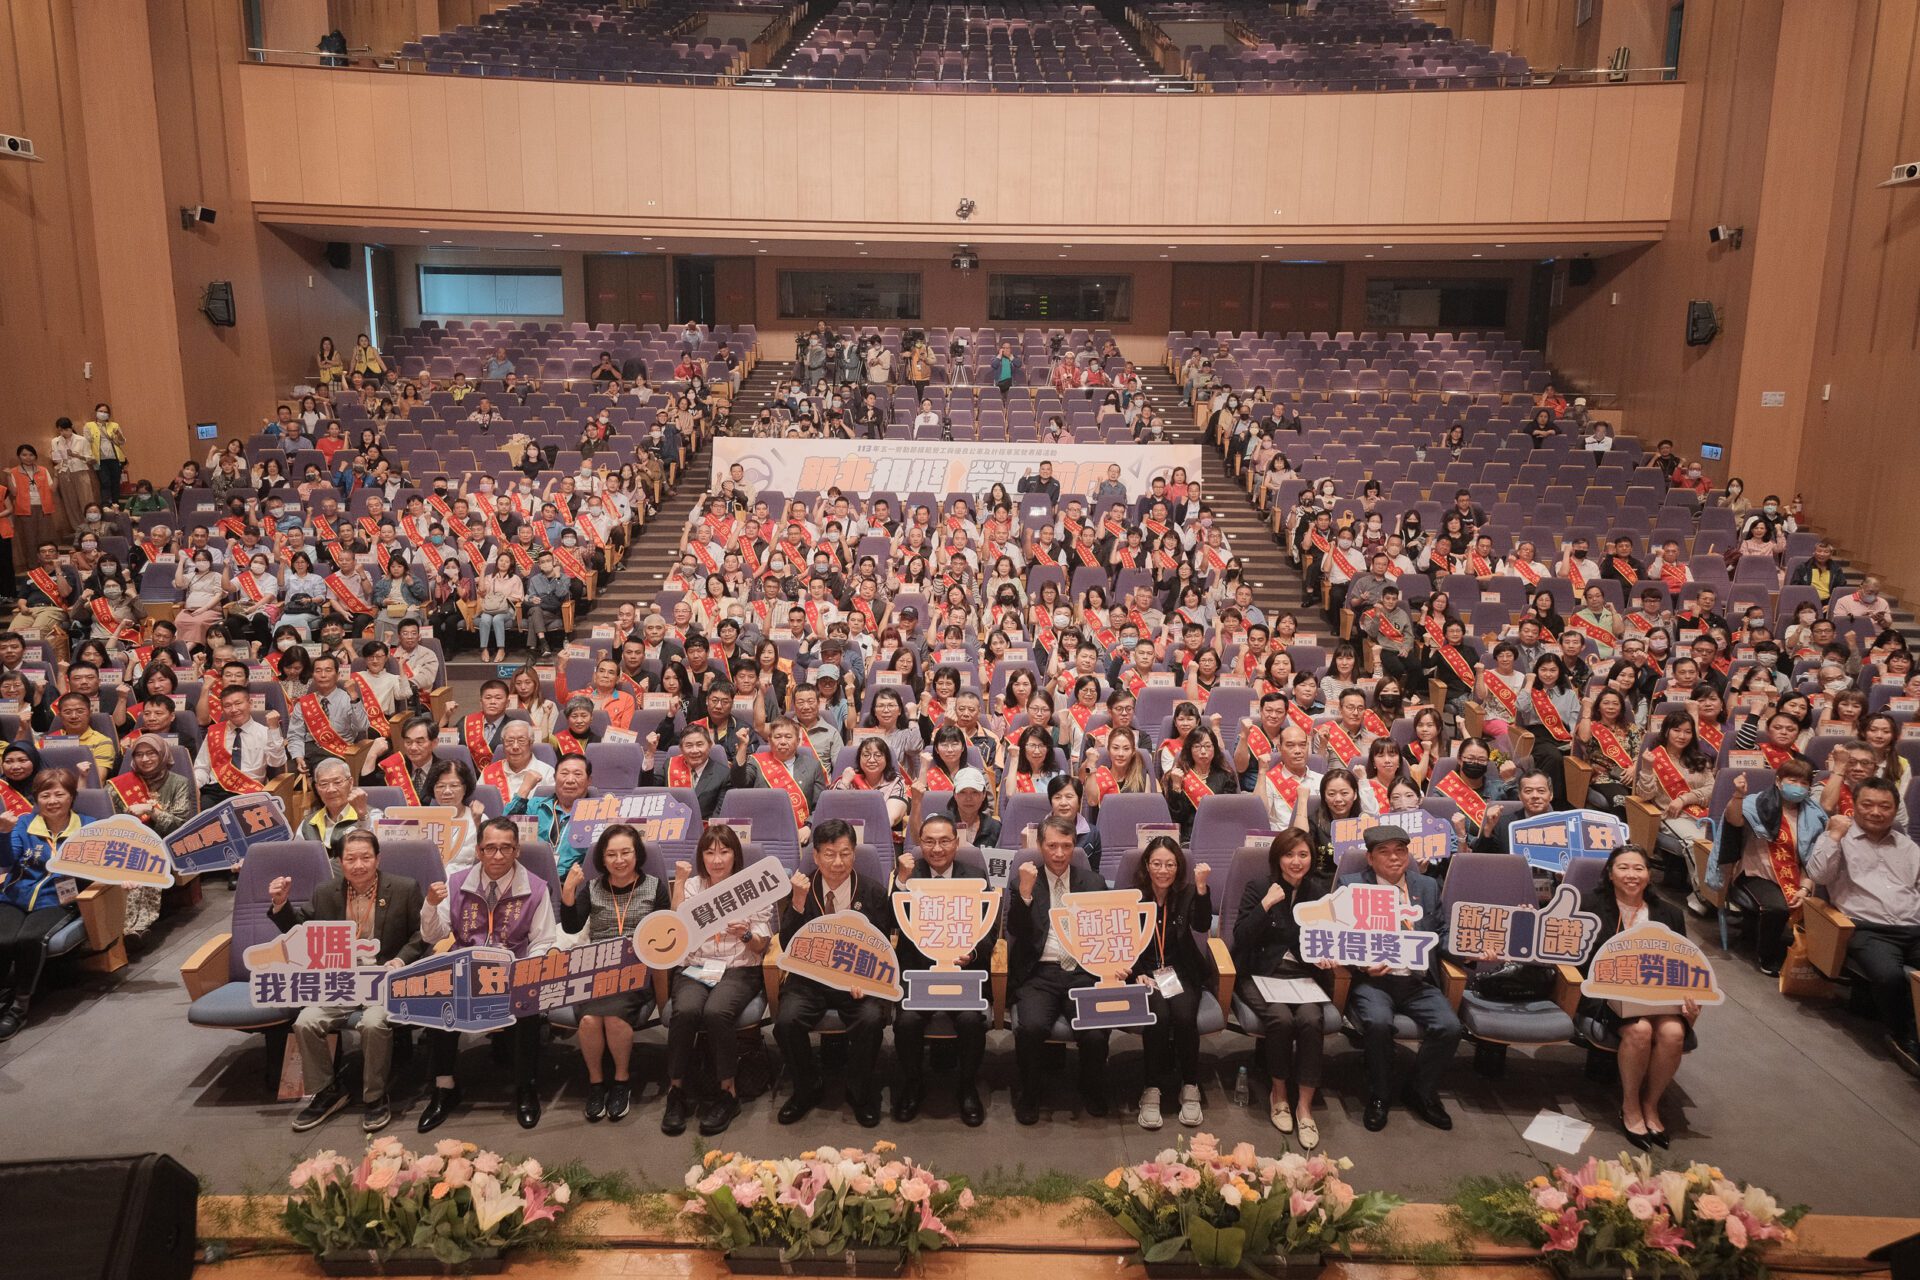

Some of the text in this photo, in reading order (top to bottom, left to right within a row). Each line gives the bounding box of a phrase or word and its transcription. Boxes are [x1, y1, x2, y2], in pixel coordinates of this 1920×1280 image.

[797, 456, 949, 494] 新北相挺
[573, 795, 667, 821] 新北相挺
[80, 828, 162, 849] NEW TAIPEI CITY
[60, 840, 166, 875] 優質勞動力
[690, 869, 780, 930] 覺得開心
[919, 895, 974, 922] 新北
[1077, 908, 1132, 937] 新北
[1458, 904, 1509, 932] 新北
[808, 922, 890, 953] NEW TAIPEI CITY
[919, 923, 974, 949] 之光
[1080, 937, 1135, 964] 之光
[1304, 929, 1434, 966] 我得獎了
[1456, 929, 1506, 957] 我最
[1543, 917, 1584, 956] 讚
[1607, 938, 1698, 956] NEW TAIPEI CITY
[513, 938, 624, 988] 新北相挺
[790, 936, 896, 985] 優質勞動力
[1593, 953, 1711, 988] 優質勞動力
[254, 971, 387, 1004] 我得獎了
[538, 962, 649, 1012] 勞工前行
